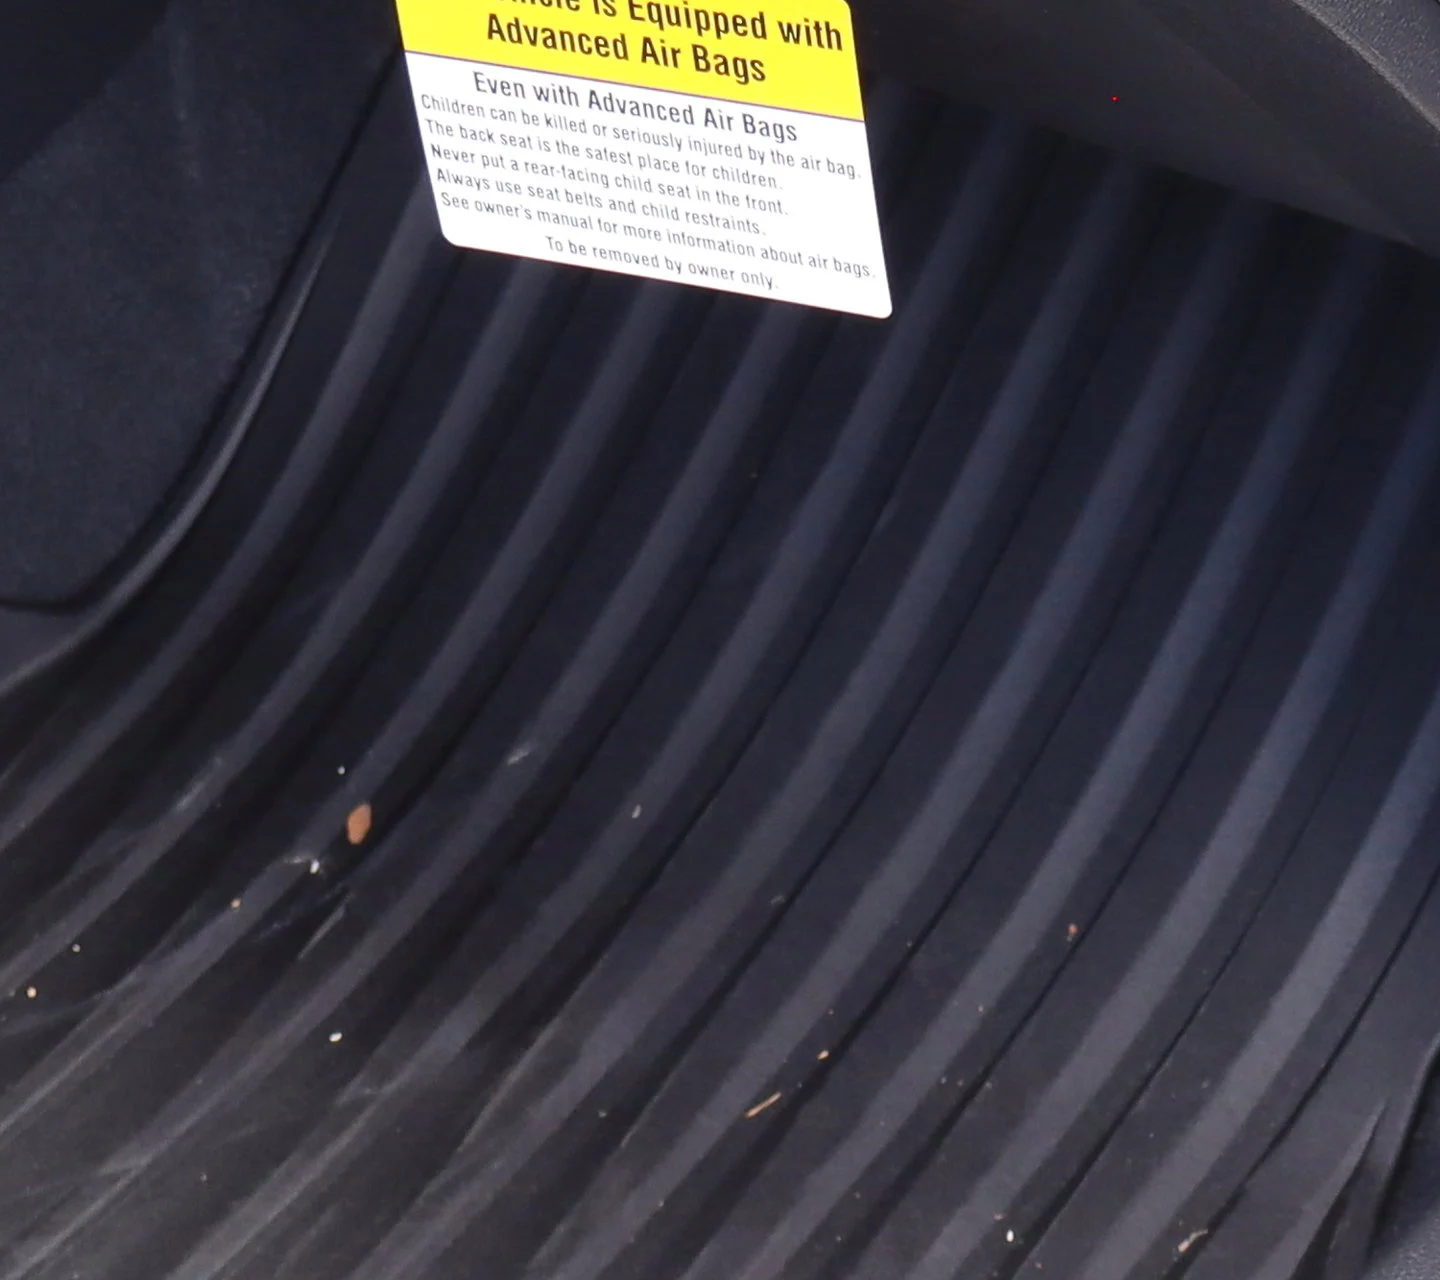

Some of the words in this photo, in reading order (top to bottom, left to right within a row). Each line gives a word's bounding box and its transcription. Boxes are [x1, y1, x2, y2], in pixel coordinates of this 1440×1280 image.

[487, 13, 629, 61] Advanced
[641, 36, 681, 69] Air
[692, 44, 766, 85] Bags
[778, 17, 843, 52] with
[421, 94, 485, 118] Children
[490, 107, 517, 123] can
[521, 110, 540, 126] be
[544, 113, 587, 134] killed
[592, 123, 607, 137] or
[612, 125, 682, 152] seriously
[688, 136, 743, 159] injured
[747, 145, 765, 166] by
[770, 149, 795, 167] the
[800, 155, 821, 171] air
[826, 157, 861, 180] bag.
[473, 71, 526, 99] Even
[532, 83, 580, 108] with
[588, 89, 695, 126] Advanced
[704, 107, 735, 131] Air
[742, 112, 798, 144] Bags
[424, 118, 454, 137] The
[459, 124, 496, 144] back
[500, 133, 533, 150] seat
[537, 136, 551, 153] is
[556, 139, 580, 157] the
[585, 147, 633, 166] safest
[637, 153, 680, 174] place
[685, 160, 707, 177] for
[712, 165, 783, 190] children.
[430, 143, 476, 164] Never
[481, 153, 506, 170] put
[510, 159, 520, 171] a
[524, 161, 609, 189] rear-facing
[614, 174, 653, 193] child
[658, 182, 691, 199] seat
[695, 185, 711, 202] in
[715, 189, 741, 207] the
[745, 194, 789, 216] front.
[437, 168, 491, 191] Always
[495, 179, 523, 195] use
[527, 184, 561, 202] seat
[564, 188, 603, 209] belts
[608, 198, 637, 214] and
[641, 202, 680, 222] child
[685, 210, 766, 236] restraints.
[441, 192, 470, 210] See
[474, 200, 532, 220] owner's
[537, 211, 593, 231] manual
[597, 217, 618, 235] for
[623, 224, 662, 242] more
[667, 229, 756, 257] information
[760, 245, 804, 266] about
[808, 254, 828, 269] air
[832, 257, 876, 279] bags.
[545, 235, 564, 252] To
[568, 239, 588, 256] be
[592, 247, 660, 269] removed
[664, 255, 682, 275] by
[688, 262, 736, 281] owner
[741, 270, 780, 291] only.
